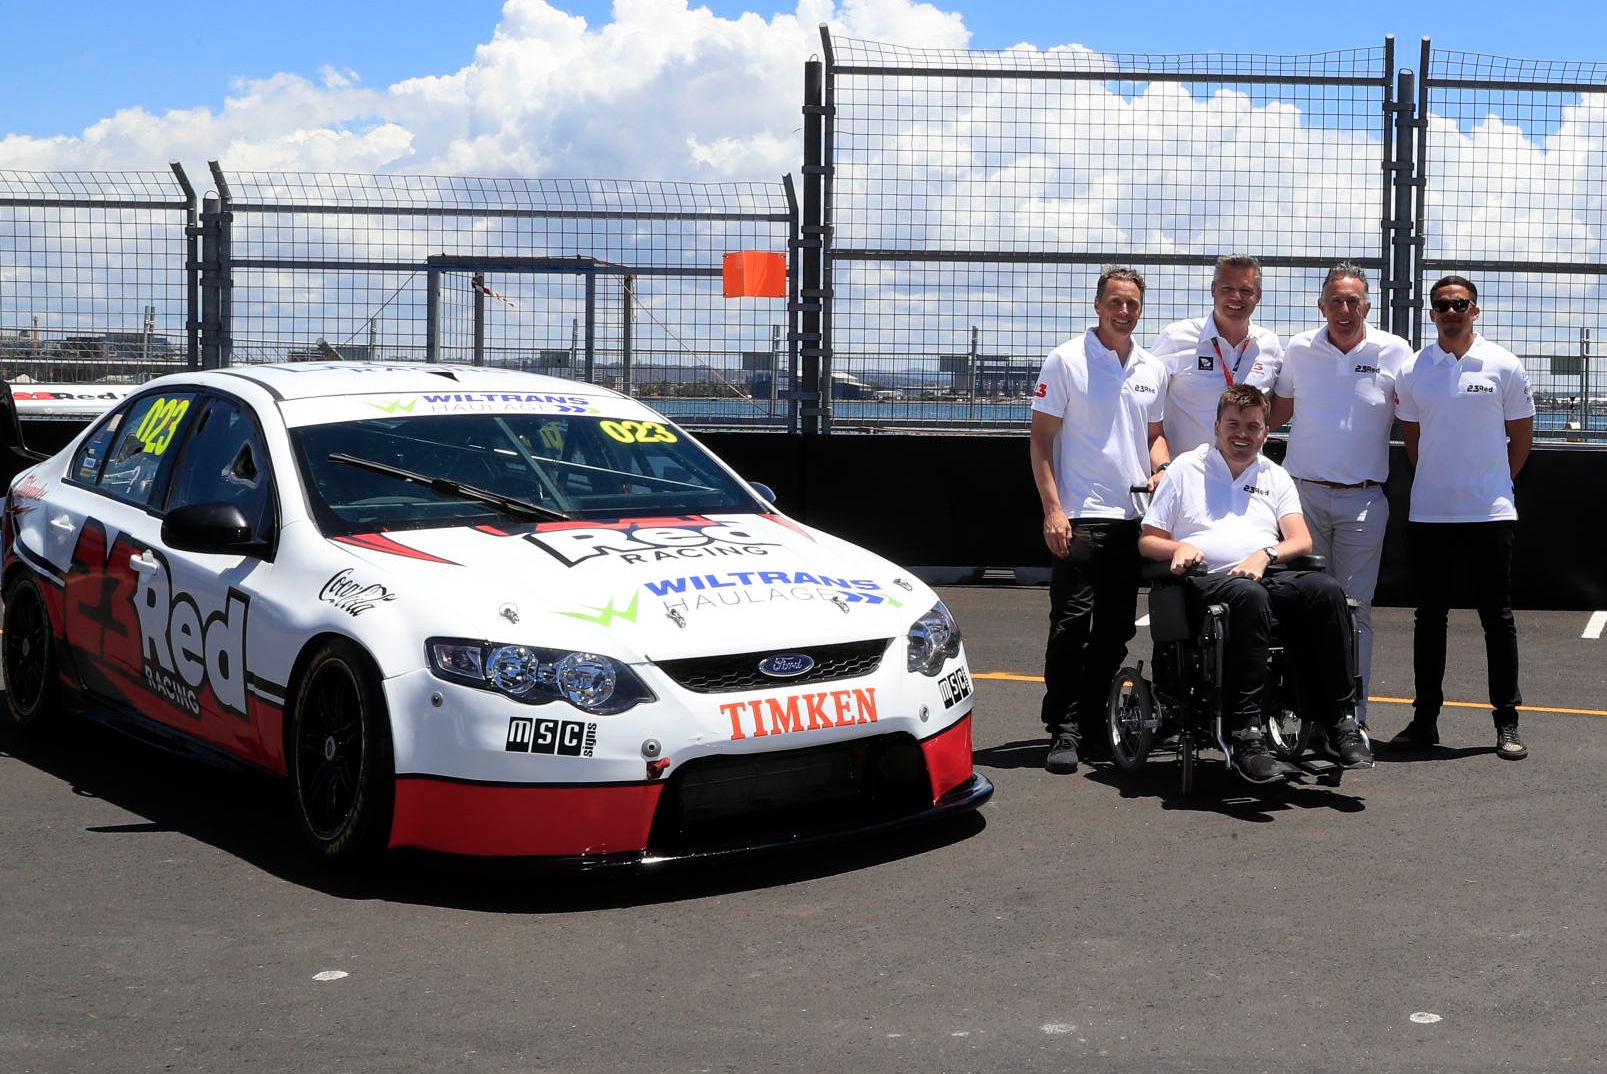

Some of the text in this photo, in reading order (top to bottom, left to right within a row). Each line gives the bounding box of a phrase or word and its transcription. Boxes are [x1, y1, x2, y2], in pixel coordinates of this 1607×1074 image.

[1355, 365, 1381, 374] 23Red
[423, 394, 590, 406] WILTRANS
[1466, 384, 1494, 393] 23Red
[431, 404, 552, 413] HAULAGE
[135, 398, 191, 456] 023
[600, 420, 678, 444] 023
[1243, 484, 1270, 496] 23Red
[619, 545, 769, 564] RACING
[643, 571, 882, 597] WILTRANS
[663, 587, 836, 613] HAULAGE
[772, 656, 803, 672] Ford
[144, 665, 200, 714] RACING
[719, 688, 878, 741] TIMKEN
[507, 719, 581, 748] MSC
[583, 722, 598, 758] signs
